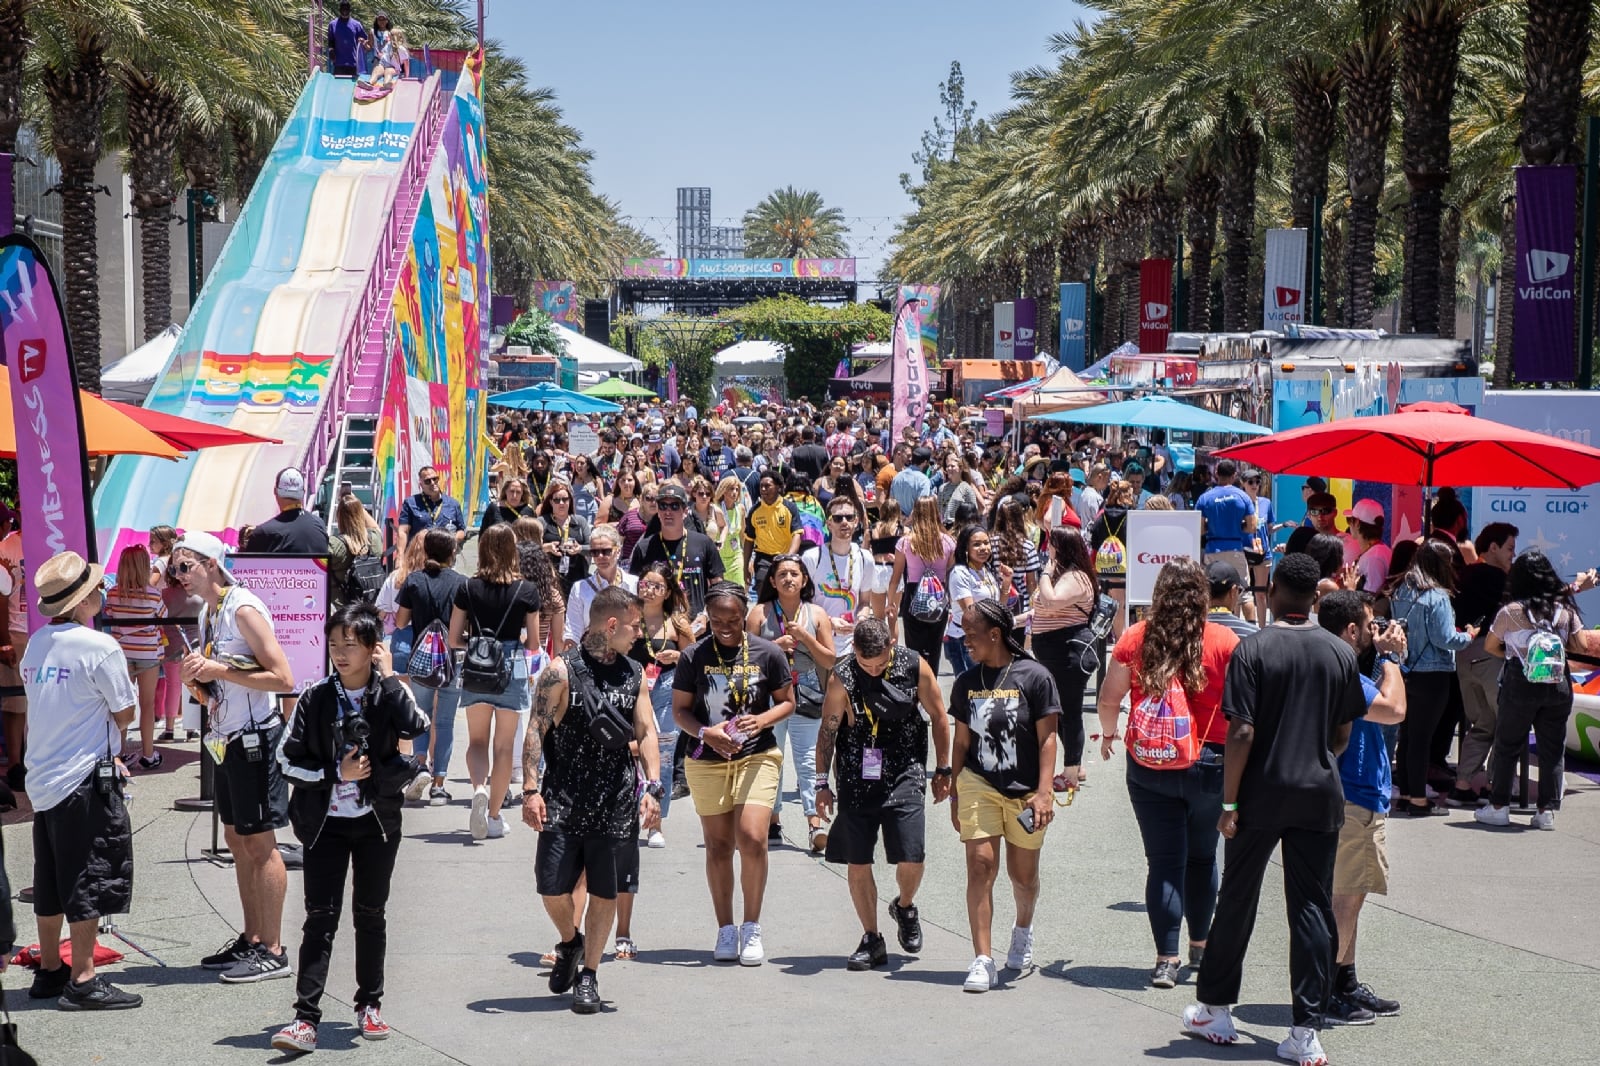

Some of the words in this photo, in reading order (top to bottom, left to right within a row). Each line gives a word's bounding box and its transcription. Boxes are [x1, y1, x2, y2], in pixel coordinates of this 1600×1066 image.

[698, 262, 772, 274] AWESOMENESS
[1519, 287, 1571, 300] VidCon
[1268, 312, 1301, 321] VidCon
[1141, 322, 1168, 330] VidCon
[23, 344, 40, 377] TV
[1176, 372, 1193, 382] MY
[851, 380, 873, 391] truth
[906, 347, 921, 428] CUPC
[1490, 500, 1527, 513] CLIQ
[1545, 500, 1589, 514] CLIQ+
[1137, 552, 1191, 564] Can
[271, 613, 325, 622] MENESSTV
[23, 666, 71, 685] STAFF
[732, 665, 760, 674] Shres
[993, 688, 1020, 699] Shores
[1135, 746, 1177, 759] Skittles
